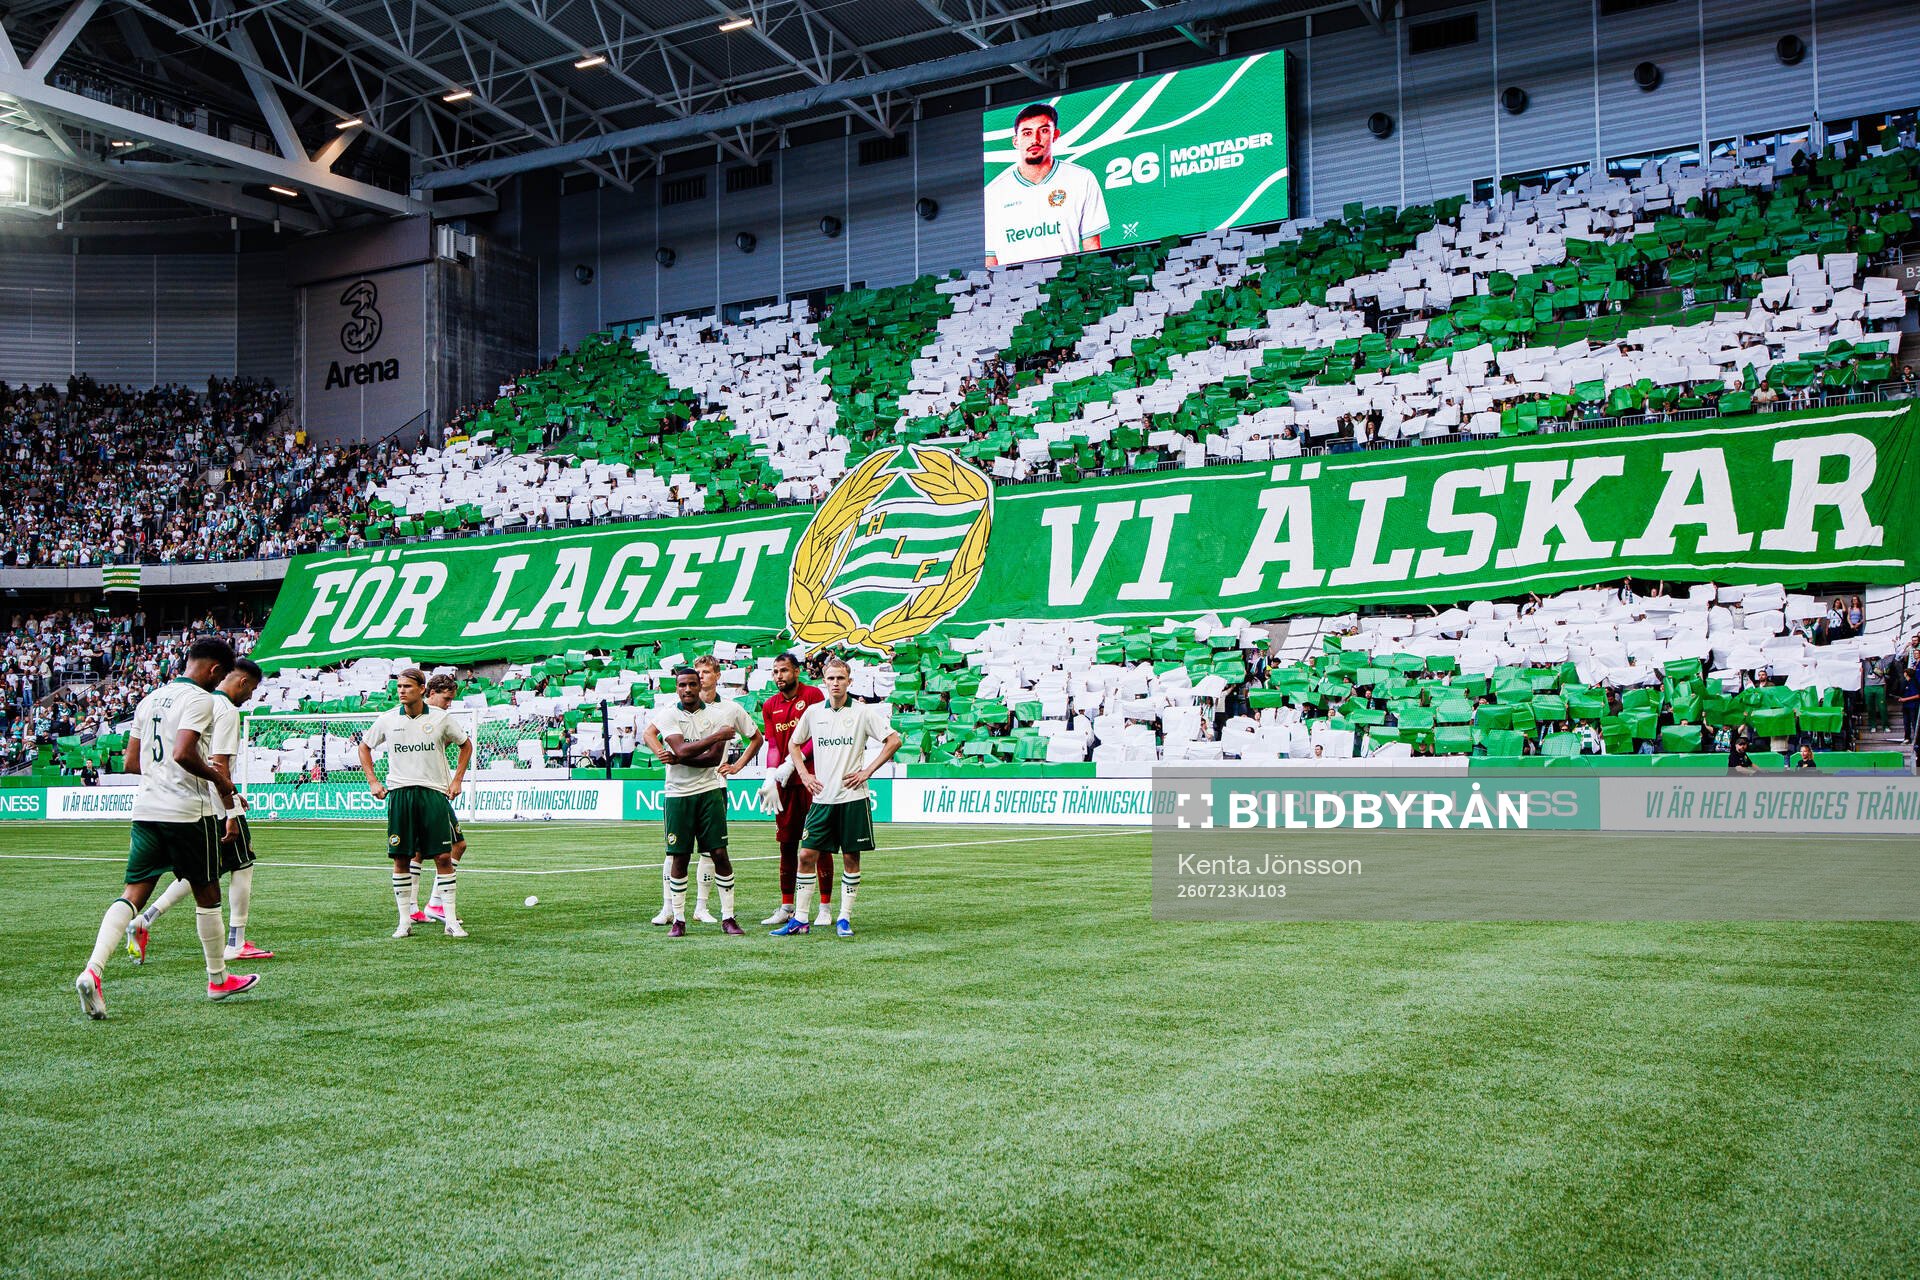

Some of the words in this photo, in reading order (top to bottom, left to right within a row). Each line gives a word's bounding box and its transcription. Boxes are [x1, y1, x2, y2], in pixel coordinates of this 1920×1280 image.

[1170, 132, 1273, 163] MONTADER
[1104, 151, 1160, 190] 26
[1170, 153, 1244, 179] MADJED
[1005, 220, 1061, 243] Revolut
[325, 358, 400, 391] Arena
[280, 549, 448, 649] FÖR
[460, 527, 792, 637] LAGET
[1041, 494, 1193, 606] VI
[1218, 433, 1884, 597] ÄLSKAR
[394, 741, 435, 753] Revolut
[818, 736, 853, 747] Revolut
[62, 794, 70, 811] VI
[70, 791, 80, 811] ÄR
[81, 794, 99, 811] HELA
[100, 794, 134, 811] SVERIGES
[516, 786, 599, 811] TRÄNINGSKLUBB
[922, 790, 936, 813] VI
[937, 786, 956, 813] ÄR
[958, 790, 991, 813] HELA
[994, 790, 1057, 814] SVERIGES
[1061, 786, 1177, 815] TRÄNINGSKLUBB
[1645, 791, 1664, 818] VI
[1667, 785, 1695, 819] ÄR
[1699, 791, 1747, 819] HELA
[1753, 791, 1849, 820] SVERIGES
